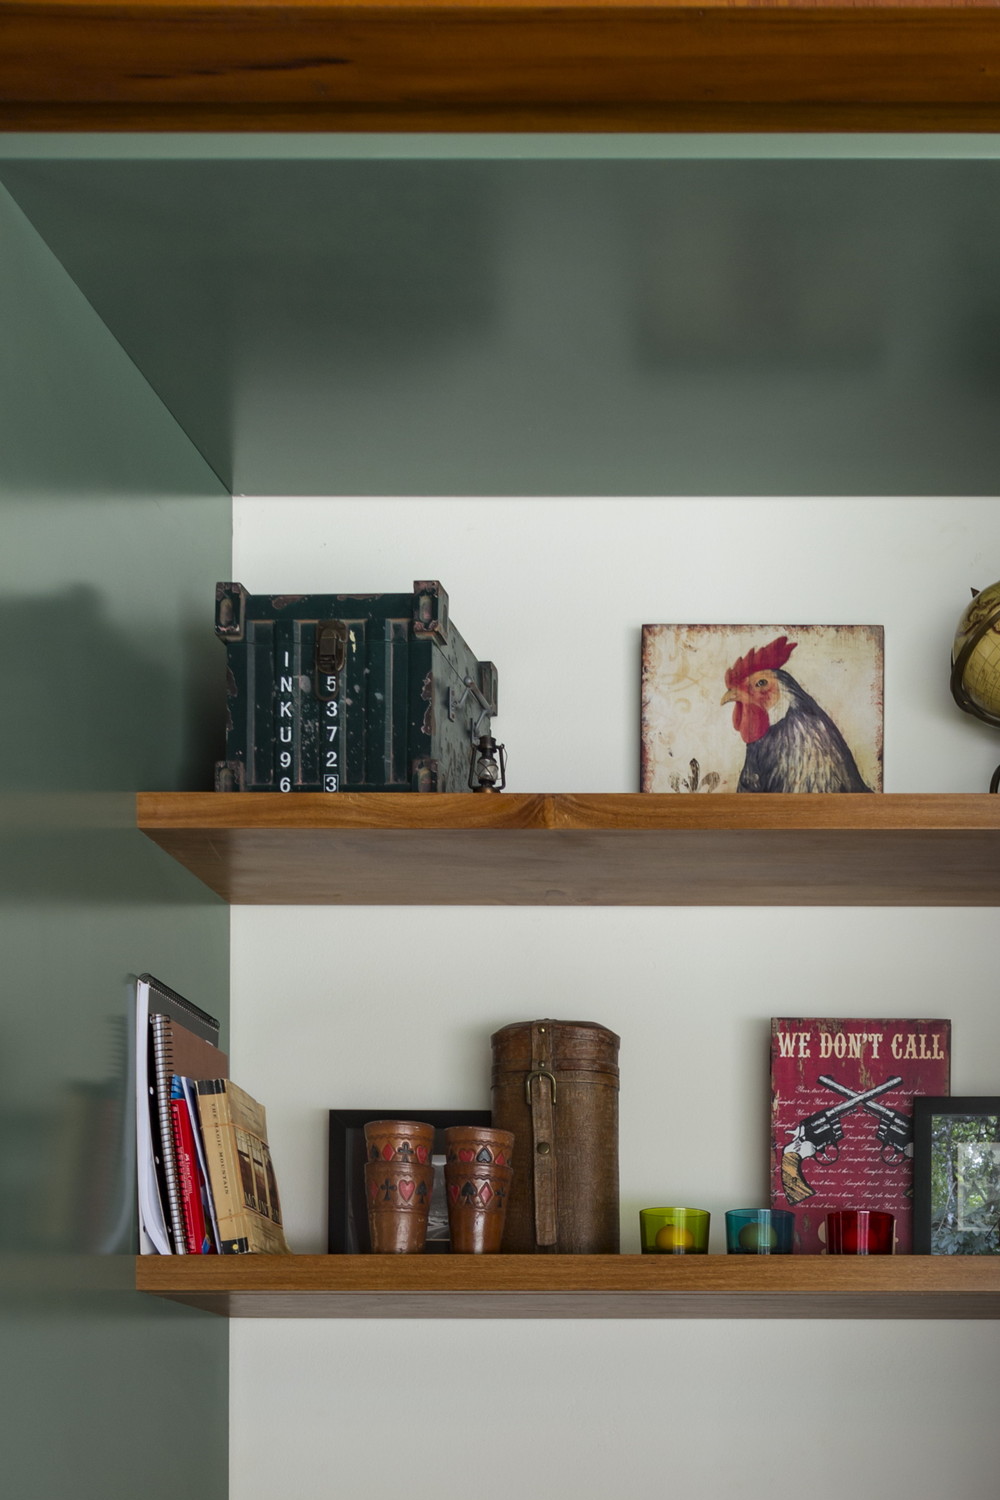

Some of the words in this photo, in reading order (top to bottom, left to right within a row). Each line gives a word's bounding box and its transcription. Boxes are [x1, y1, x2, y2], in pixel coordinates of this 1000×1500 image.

[776, 1032, 811, 1058] WE
[819, 1032, 883, 1059] DON'T
[891, 1033, 945, 1060] CALL
[219, 1152, 229, 1195] MOUNTAIN
